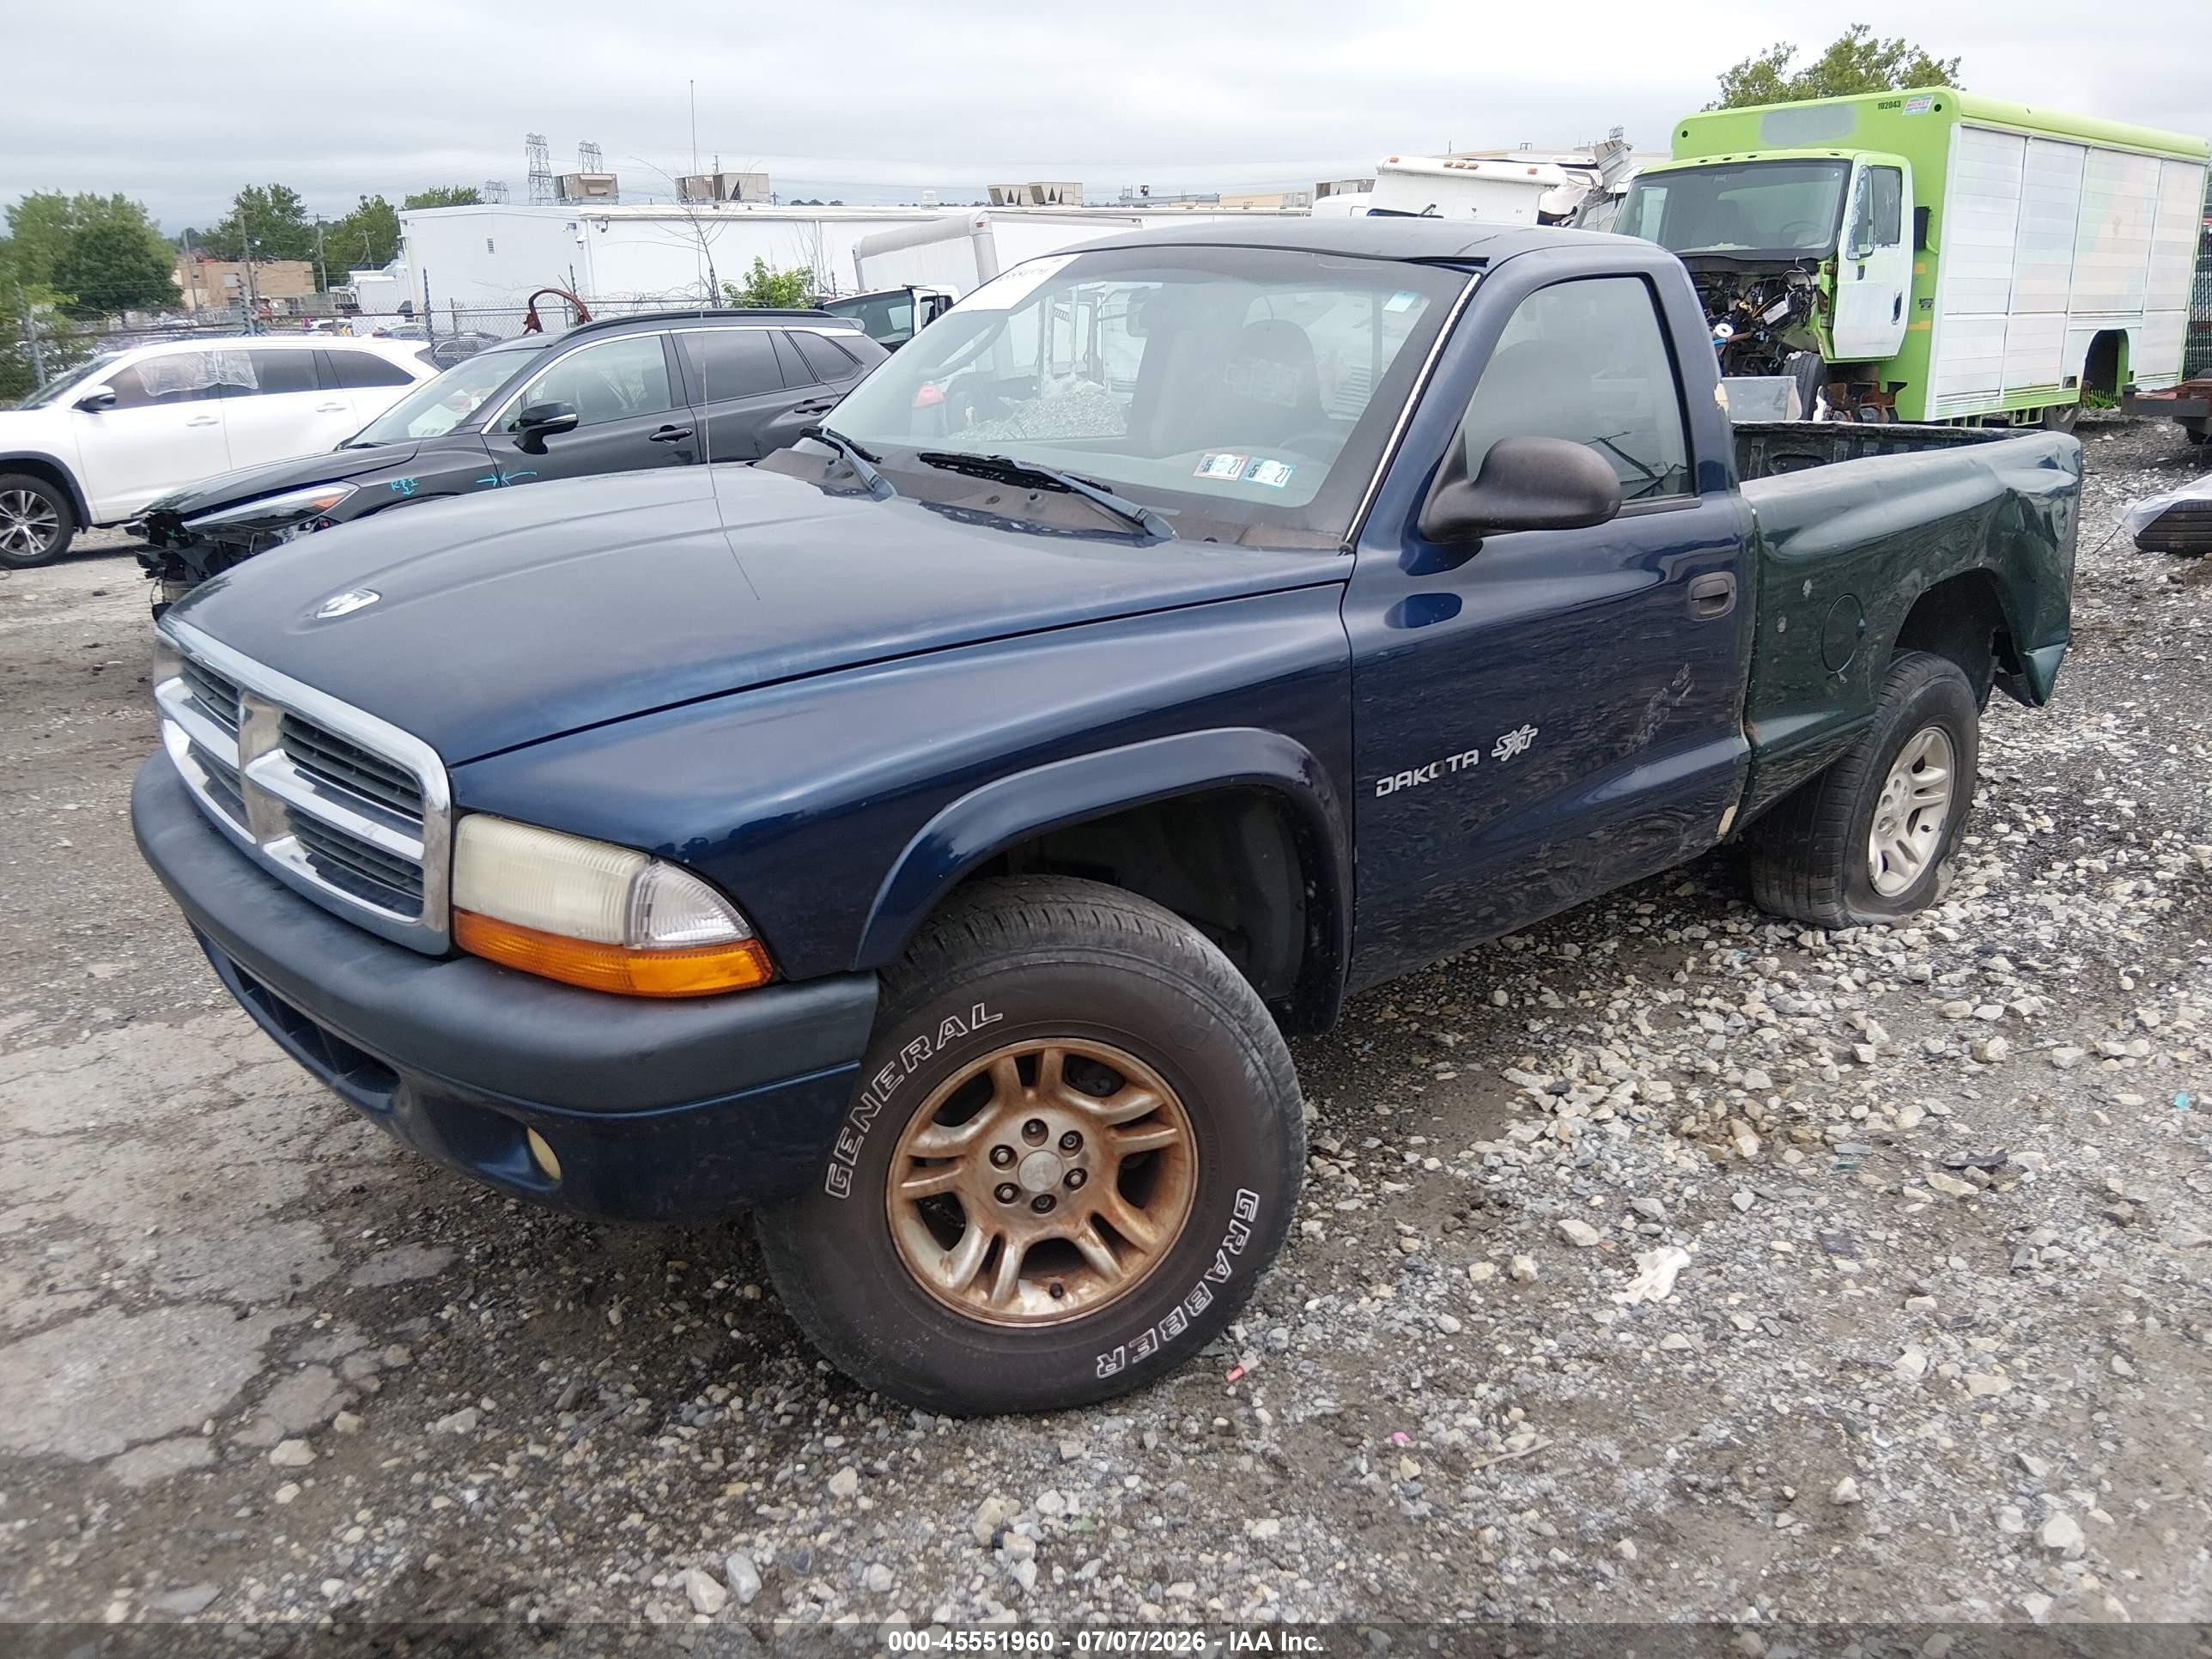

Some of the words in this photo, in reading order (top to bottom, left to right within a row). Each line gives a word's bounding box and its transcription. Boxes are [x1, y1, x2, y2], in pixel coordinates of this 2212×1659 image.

[1878, 100, 1901, 110] 102043
[1228, 459, 1244, 475] 27
[1273, 467, 1291, 483] 27
[824, 1002, 1003, 1199] GENERAL
[1097, 1188, 1260, 1379] GRABBER
